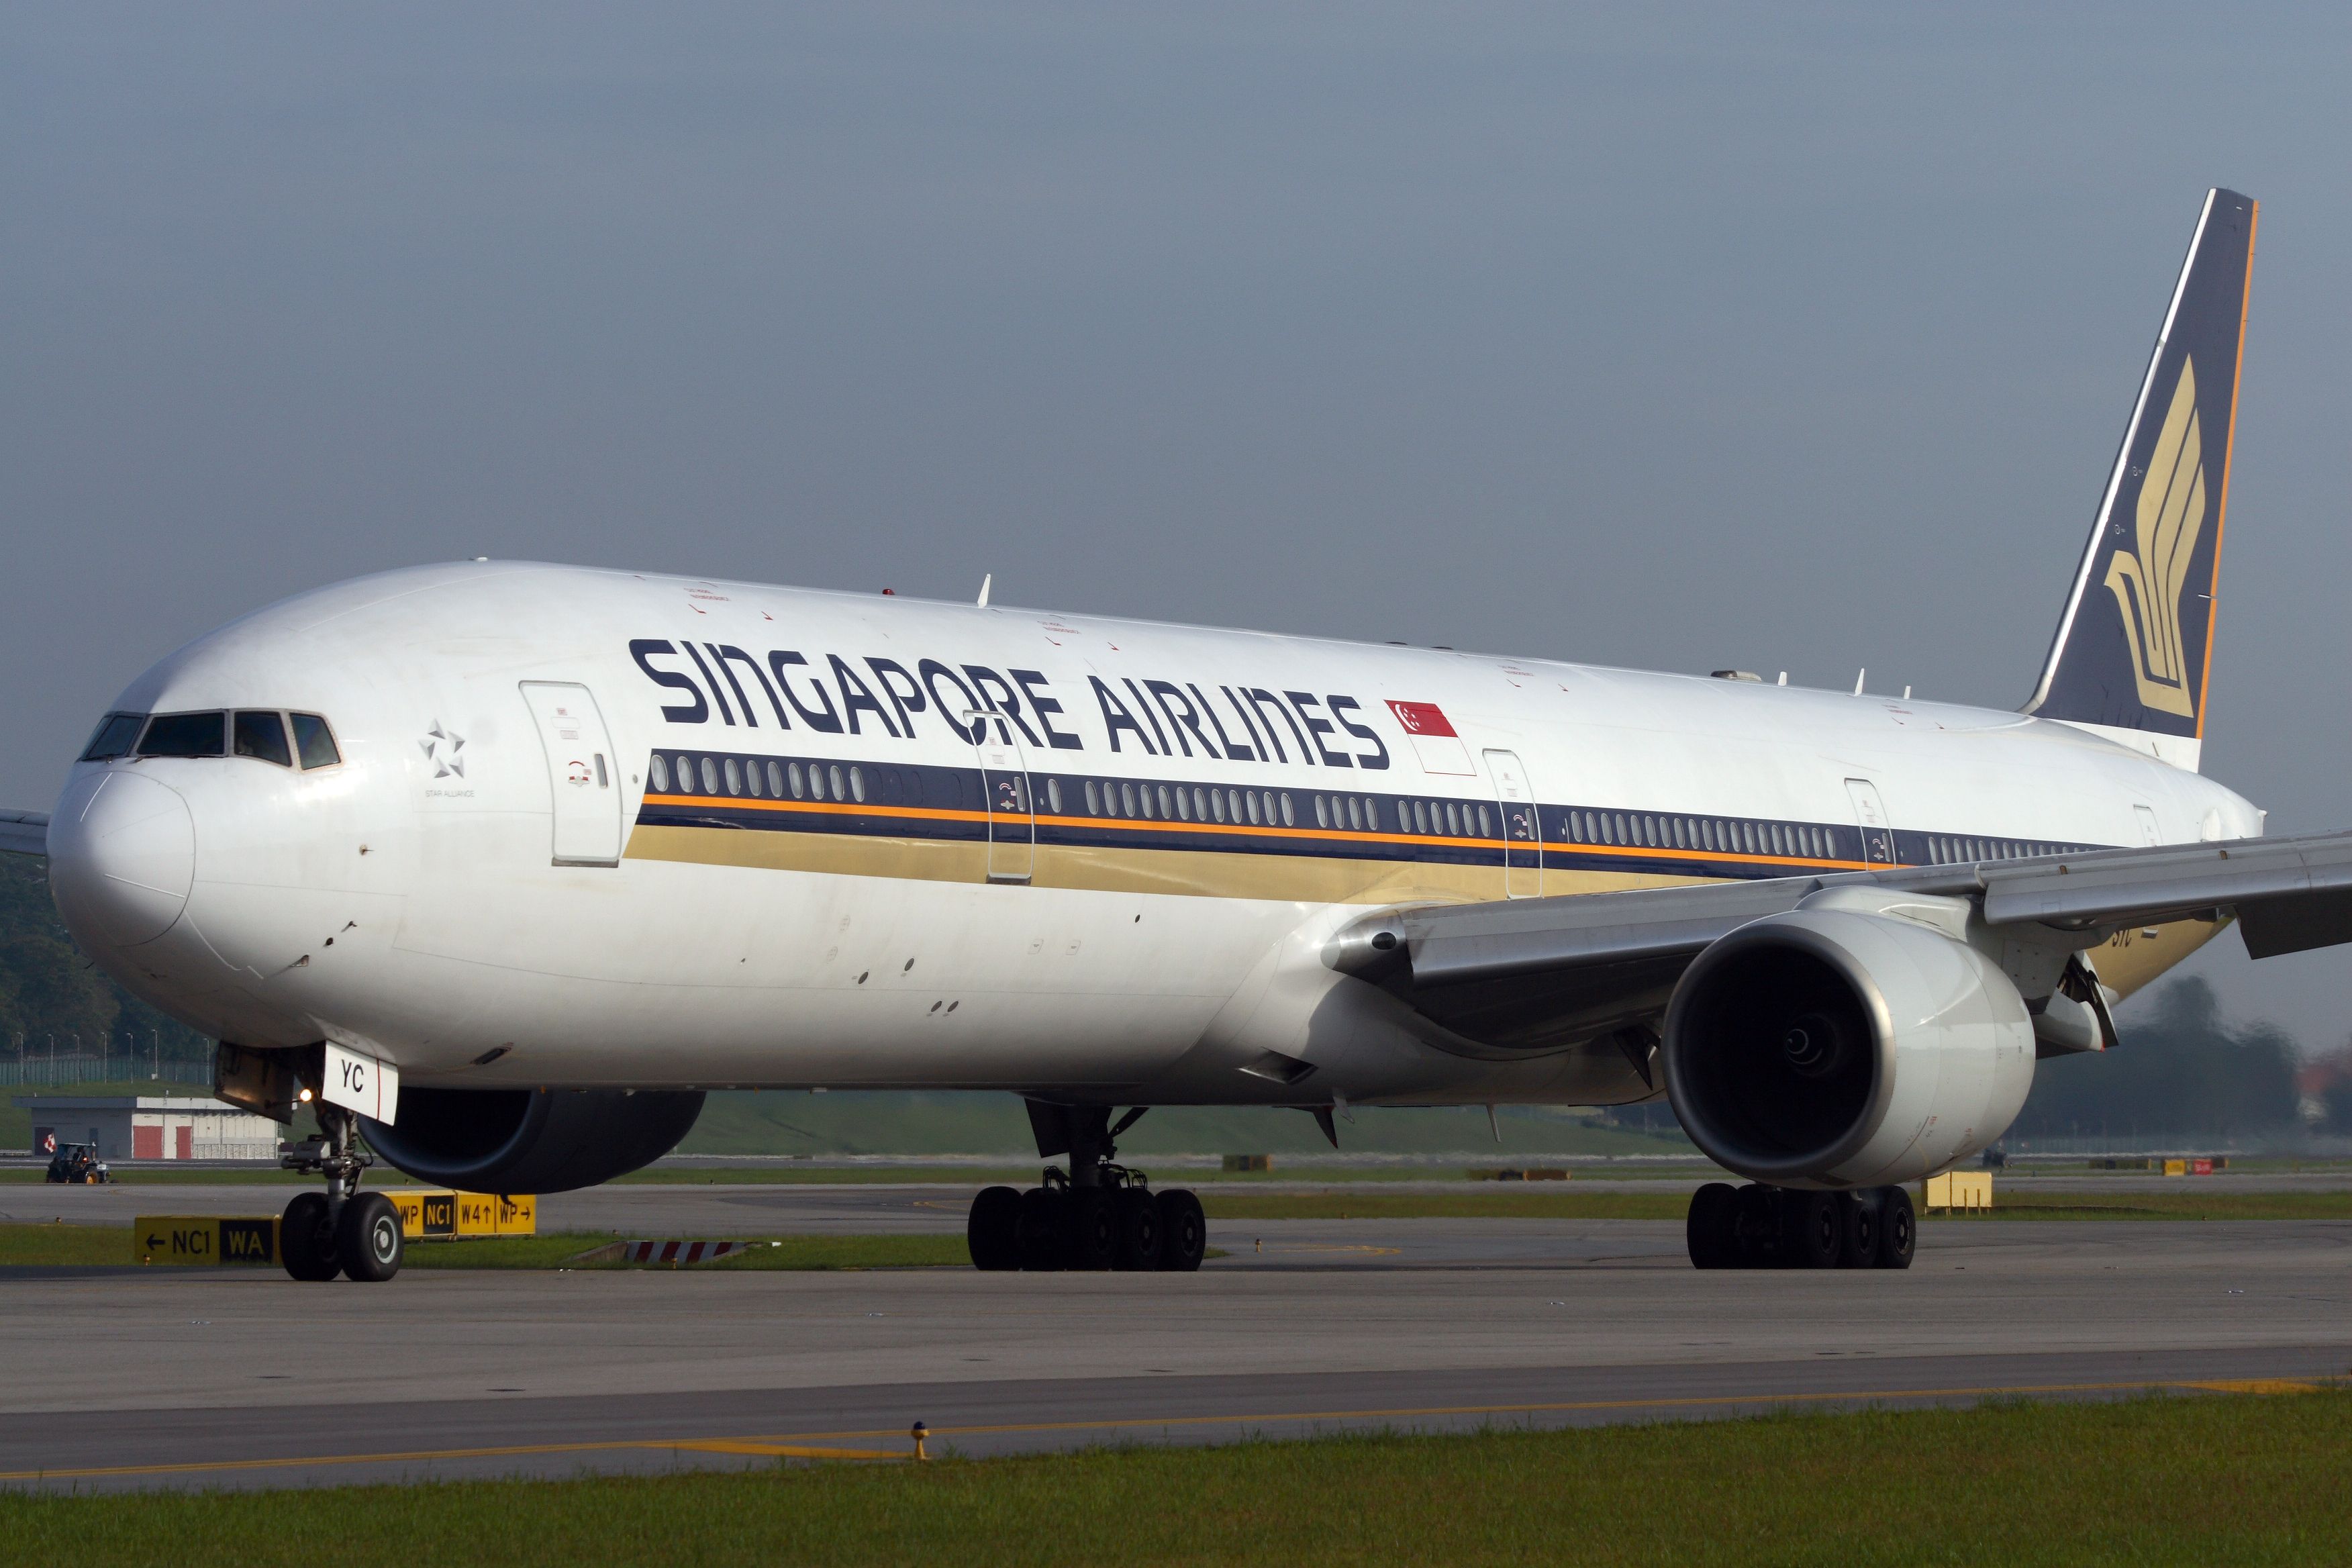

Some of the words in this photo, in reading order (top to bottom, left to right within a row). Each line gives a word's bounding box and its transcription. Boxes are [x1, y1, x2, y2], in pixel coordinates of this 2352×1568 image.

[629, 639, 1084, 750] SINGAPORE
[1087, 675, 1390, 770] AIRLINES
[425, 789, 442, 797] STAR
[342, 1059, 364, 1093] YC
[400, 1205, 418, 1225] WP
[427, 1204, 450, 1225] NC1
[462, 1204, 480, 1224] W4
[500, 1204, 517, 1224] WP
[173, 1230, 210, 1254] NC1
[229, 1231, 264, 1255] WA
